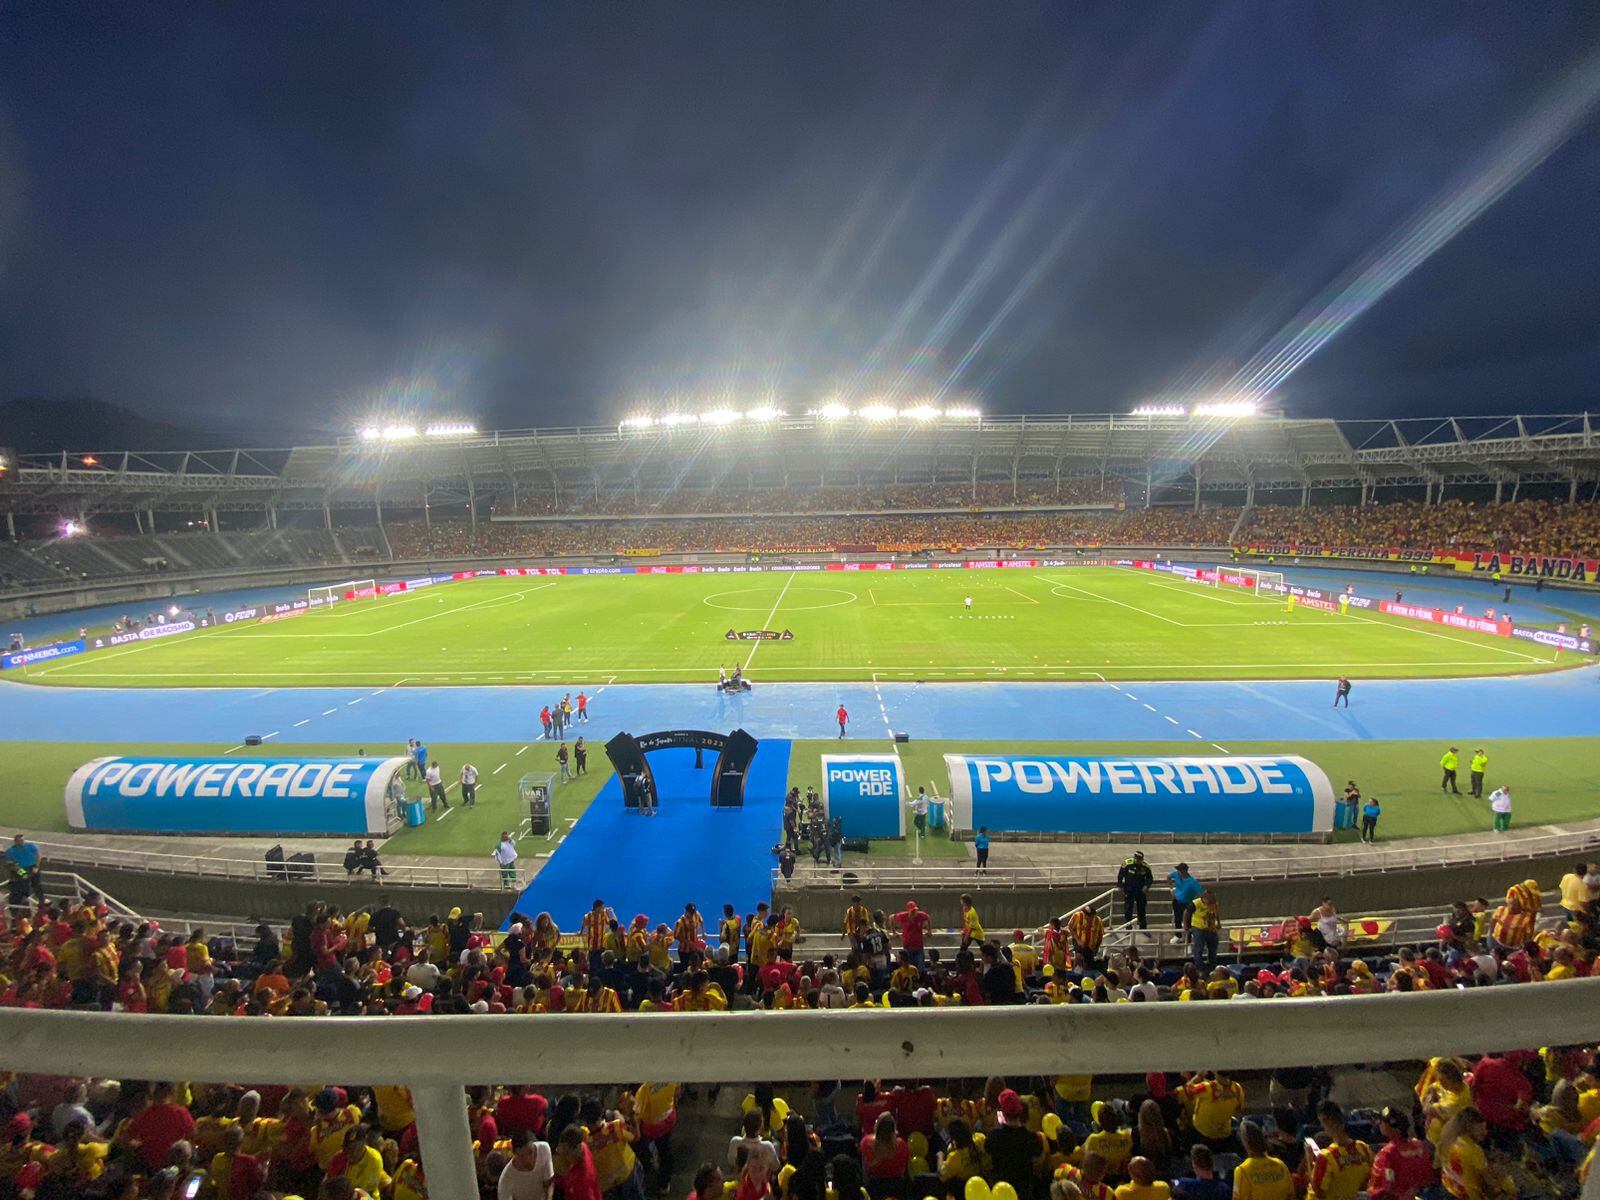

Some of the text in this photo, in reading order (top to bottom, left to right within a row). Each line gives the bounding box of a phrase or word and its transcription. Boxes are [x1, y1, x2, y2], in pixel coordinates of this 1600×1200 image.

[1256, 544, 1434, 561] LOBO SUR PEREIRA 1999
[504, 568, 521, 576] TCL
[525, 568, 542, 576] TCL
[545, 568, 562, 576] TCL
[1473, 552, 1501, 573] LA
[1509, 556, 1586, 582] BANDA
[1301, 597, 1336, 610] AMSTEL
[110, 632, 139, 645] BASTA
[144, 628, 155, 637] DE
[156, 622, 190, 635] RACISMO
[1513, 628, 1534, 638] BASTA
[701, 738, 724, 747] 2023
[88, 762, 364, 799] POWERADE
[830, 769, 892, 783] POWER
[973, 759, 1294, 795] POWERADE
[859, 781, 893, 796] ADE
